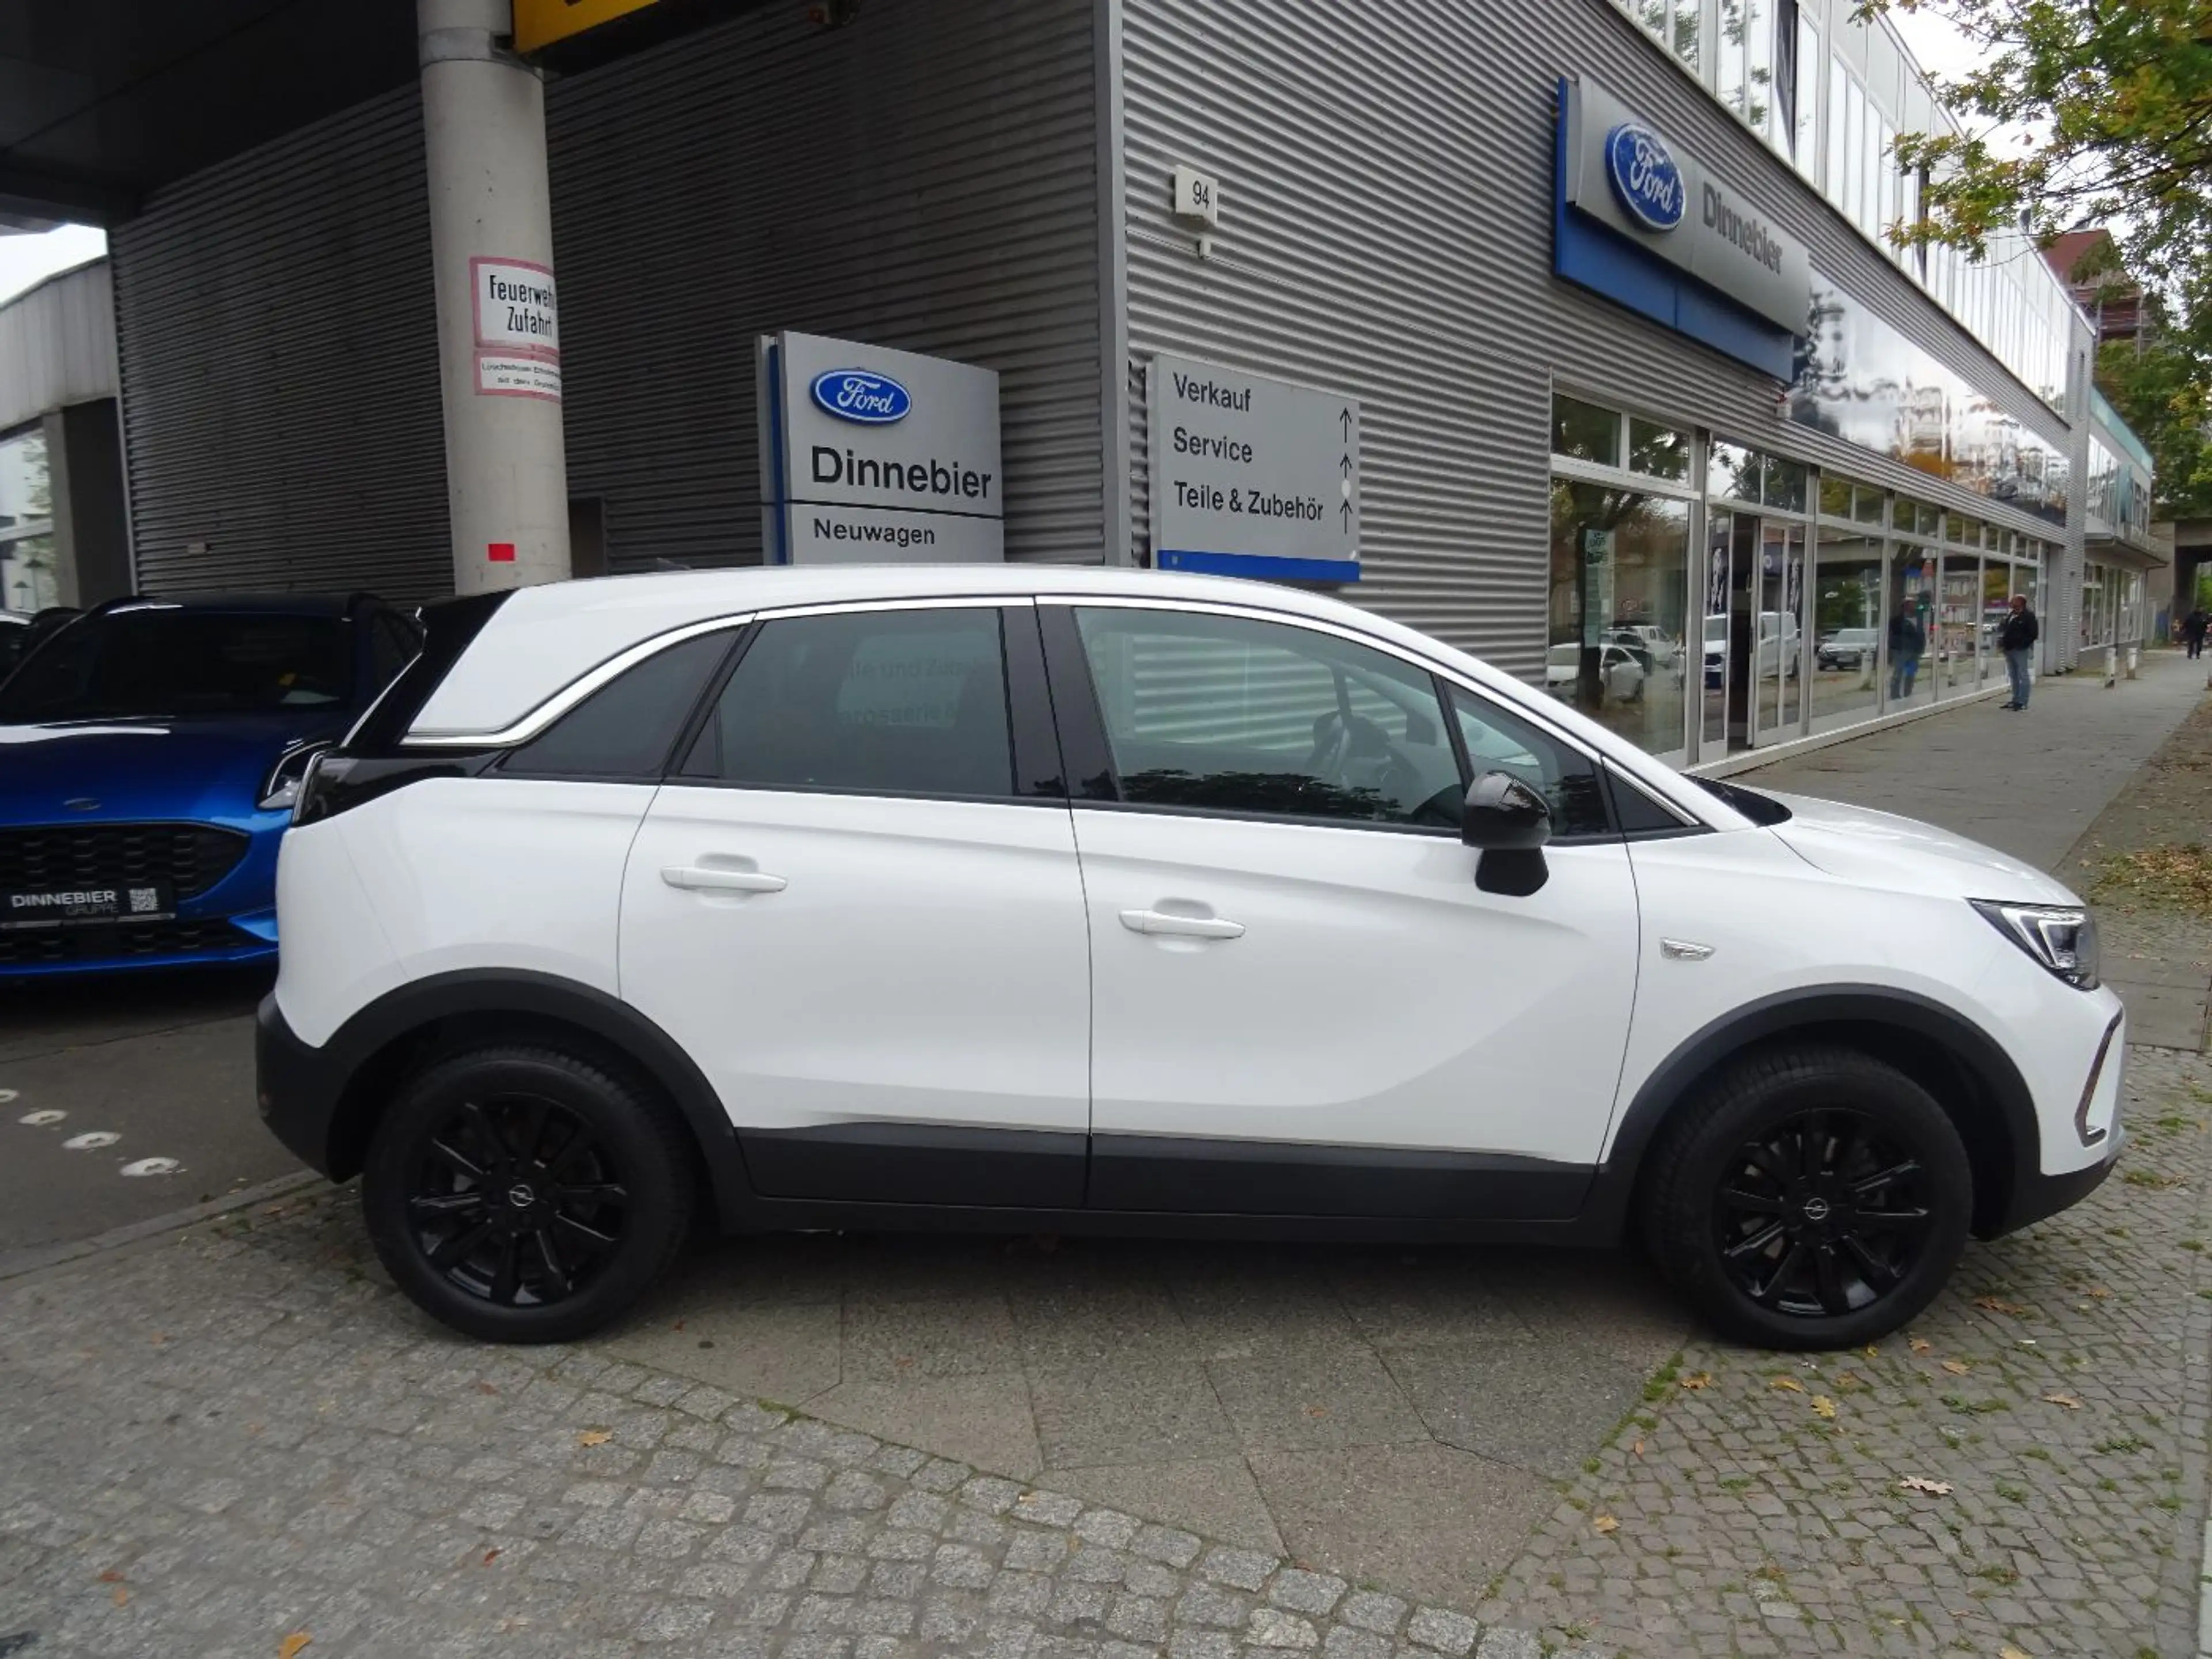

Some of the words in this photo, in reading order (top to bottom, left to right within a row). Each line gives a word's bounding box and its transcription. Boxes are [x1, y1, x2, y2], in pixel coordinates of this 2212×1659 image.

[1630, 135, 1675, 213] Ford
[1193, 180, 1209, 209] 94
[1702, 181, 1783, 276] Dinnebier
[489, 274, 554, 309] Feuerweh
[507, 306, 552, 338] Zufahrt
[836, 376, 893, 414] Ford
[1173, 372, 1251, 412] Verkauf
[1173, 426, 1253, 463] Service
[812, 445, 993, 498] Dinnebier
[1174, 480, 1224, 510] Teile
[1229, 488, 1243, 513] &
[1248, 490, 1324, 521] Zubehör
[813, 518, 935, 547] Neuwagen
[11, 890, 116, 908] DINNEBIER
